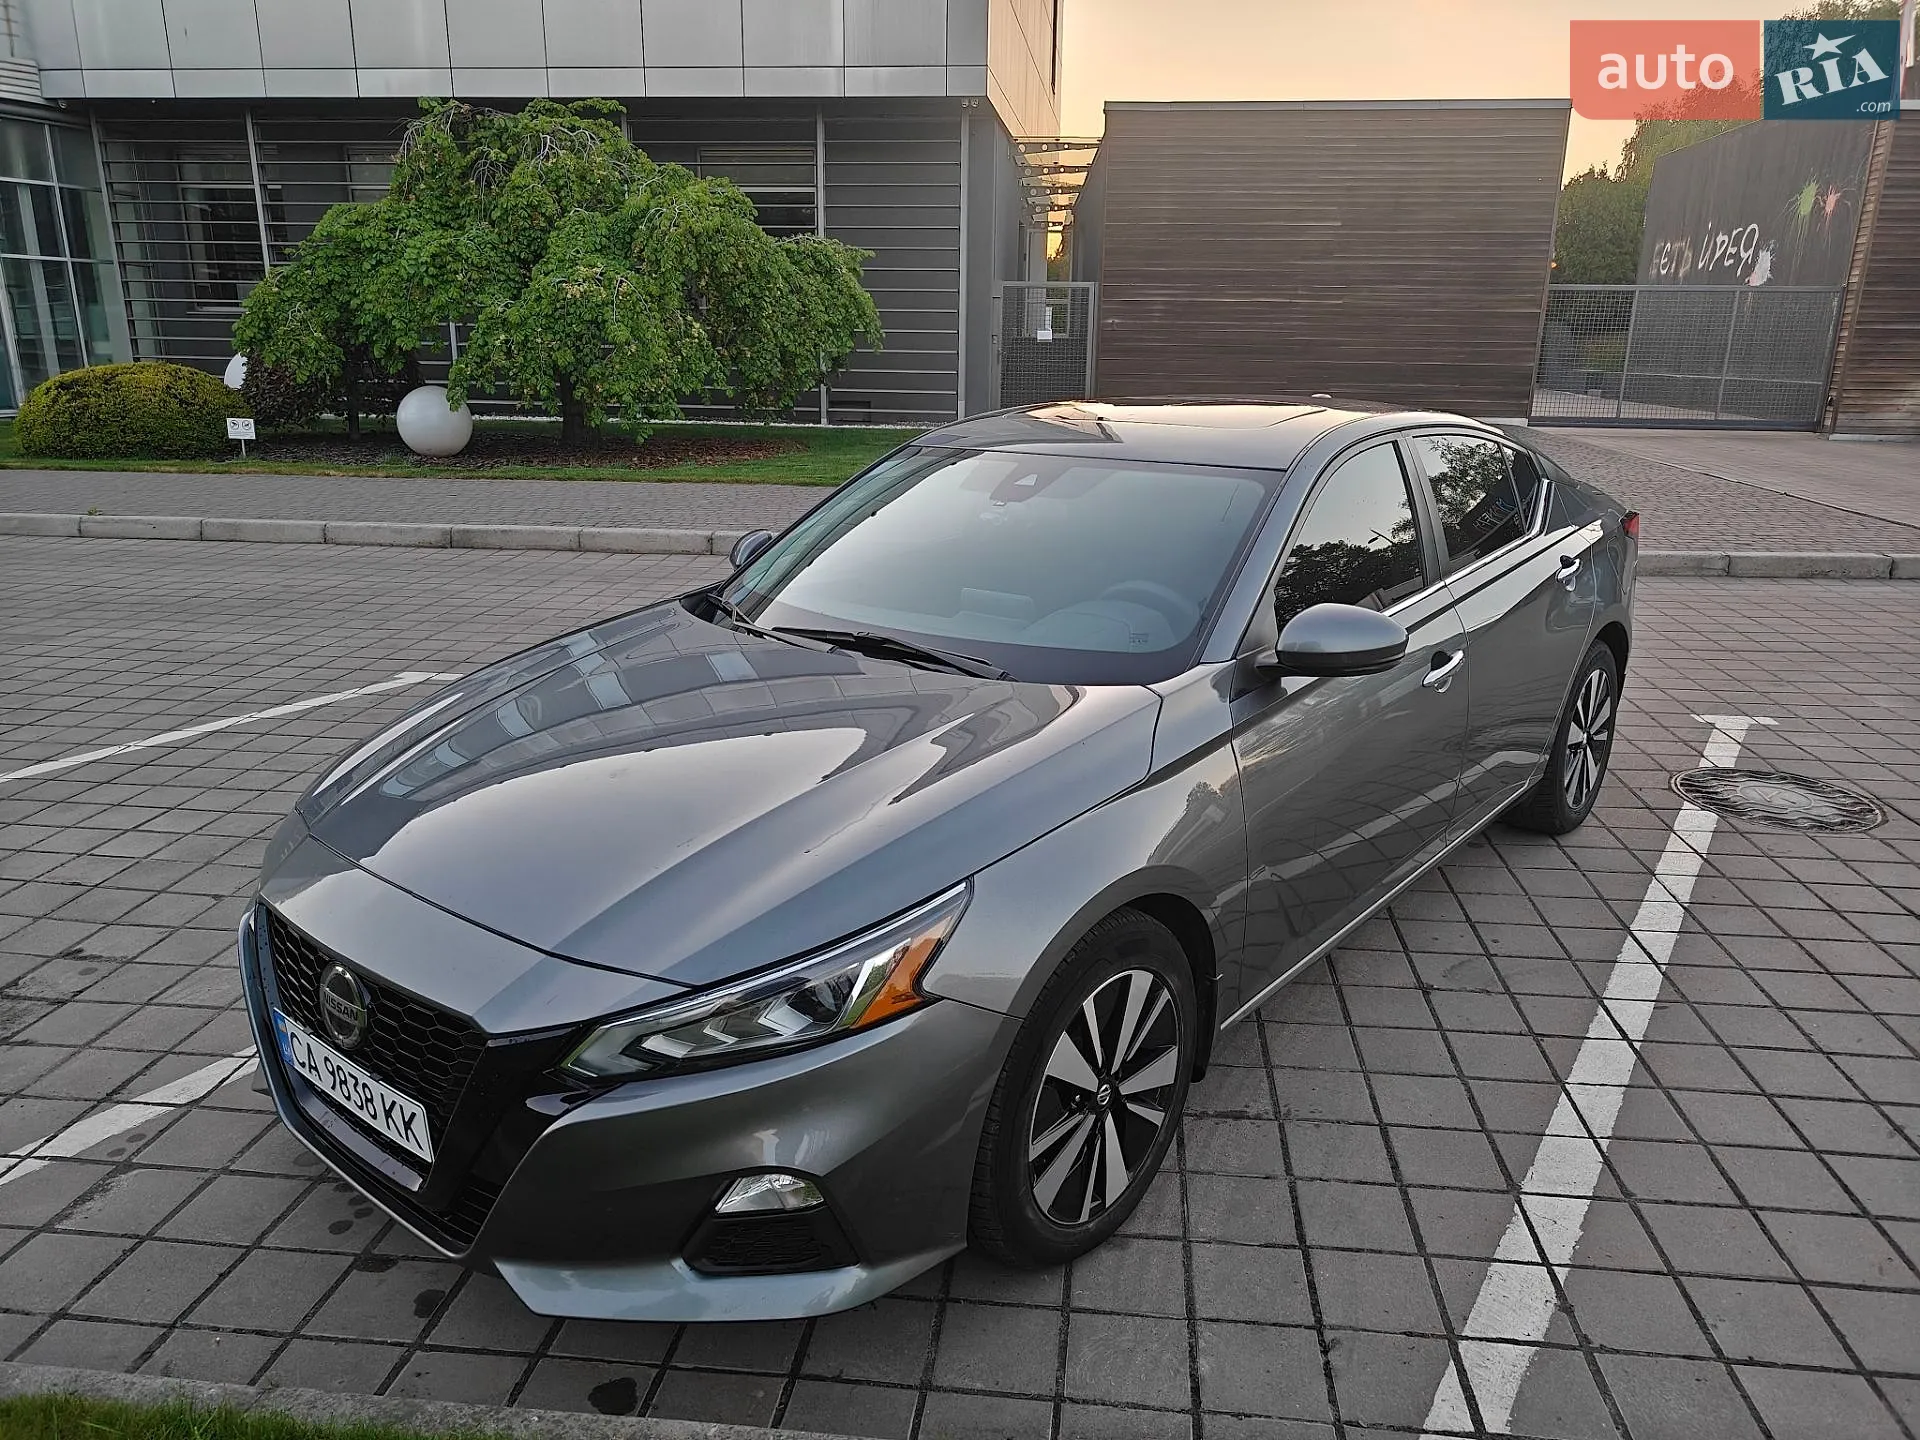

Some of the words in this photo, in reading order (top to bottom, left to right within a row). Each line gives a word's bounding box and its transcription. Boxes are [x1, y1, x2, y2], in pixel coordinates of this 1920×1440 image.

[324, 990, 358, 1021] NISSAN
[290, 1031, 324, 1083] CA
[323, 1056, 378, 1121] 9838
[380, 1092, 425, 1151] KK
